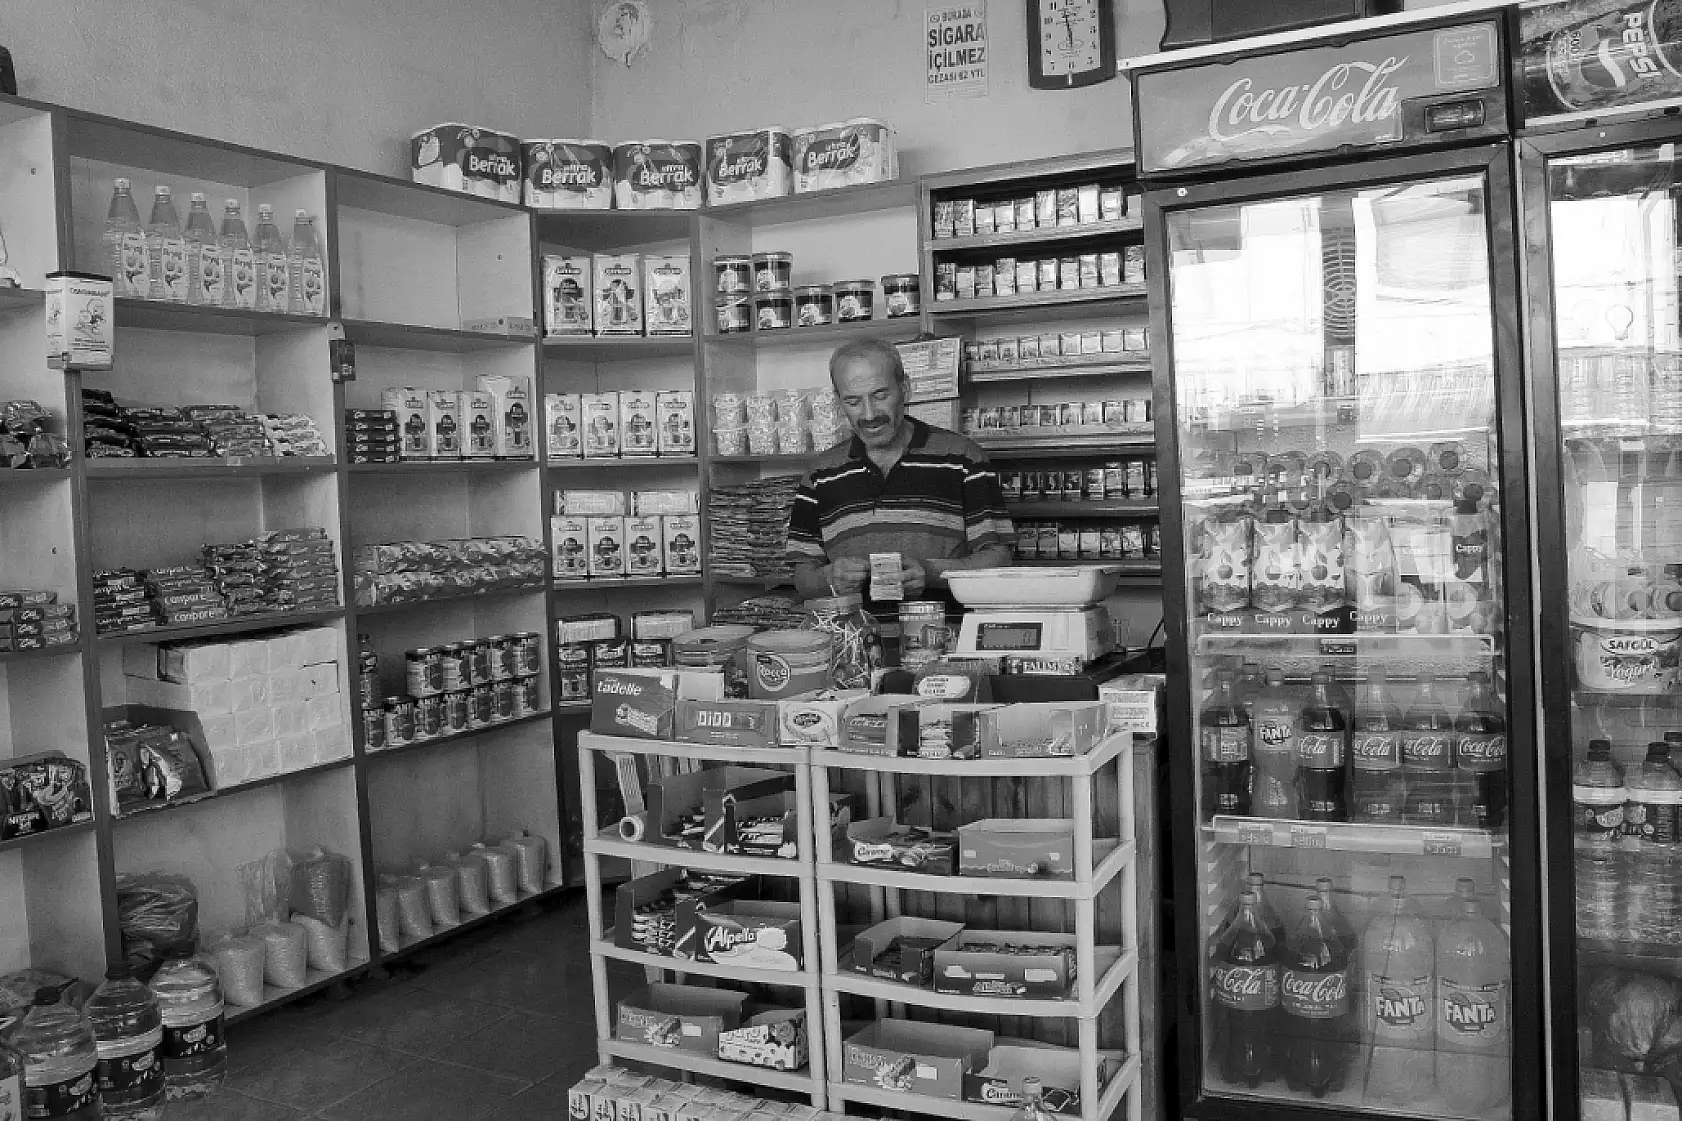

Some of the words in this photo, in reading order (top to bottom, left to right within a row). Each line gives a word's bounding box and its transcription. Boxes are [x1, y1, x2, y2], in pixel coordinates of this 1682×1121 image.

[929, 22, 985, 48] SİGARA
[1622, 11, 1663, 78] PEPSI
[929, 47, 985, 73] İÇİLMEZ
[1209, 54, 1411, 141] Coca-Cola
[1375, 995, 1425, 1018] FANTA
[1443, 998, 1495, 1024] FANTA
